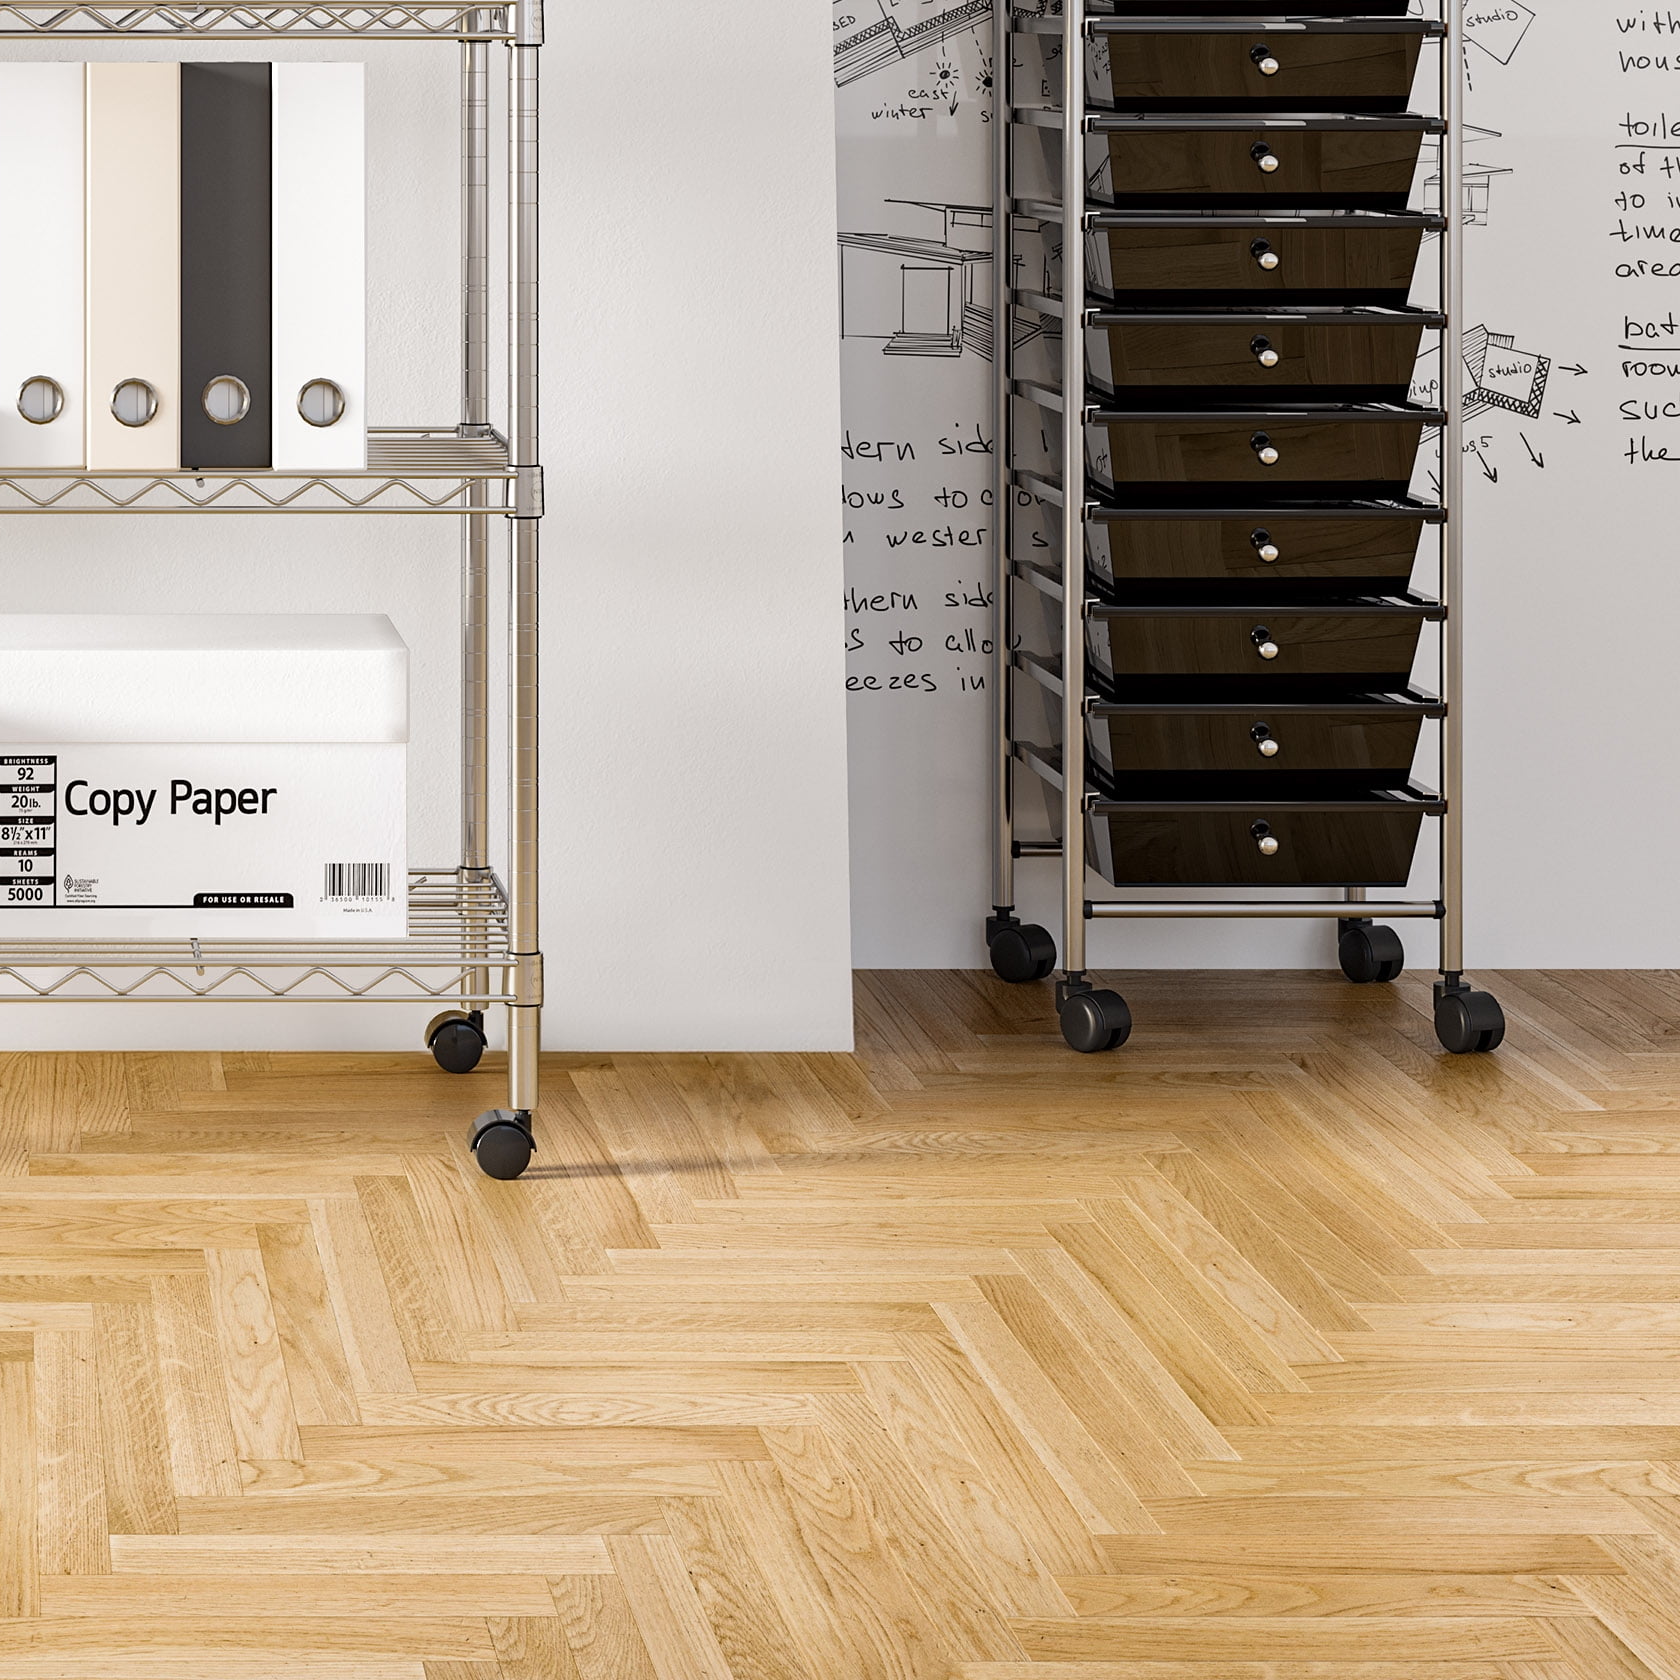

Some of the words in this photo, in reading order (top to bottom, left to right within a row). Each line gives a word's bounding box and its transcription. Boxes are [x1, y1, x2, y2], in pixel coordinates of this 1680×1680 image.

[1466, 8, 1519, 29] studio
[908, 88, 950, 101] east
[871, 102, 934, 121] winter
[1618, 150, 1646, 176] of
[1614, 190, 1646, 212] to
[1488, 361, 1532, 379] studio
[934, 486, 968, 509] to
[888, 629, 923, 656] to
[957, 666, 986, 692] in
[17, 767, 34, 781] 92
[11, 785, 40, 793] WEIGHT
[64, 779, 157, 826] Copy
[170, 779, 278, 826] Paper
[17, 859, 34, 873] 10
[7, 887, 43, 901] 5000
